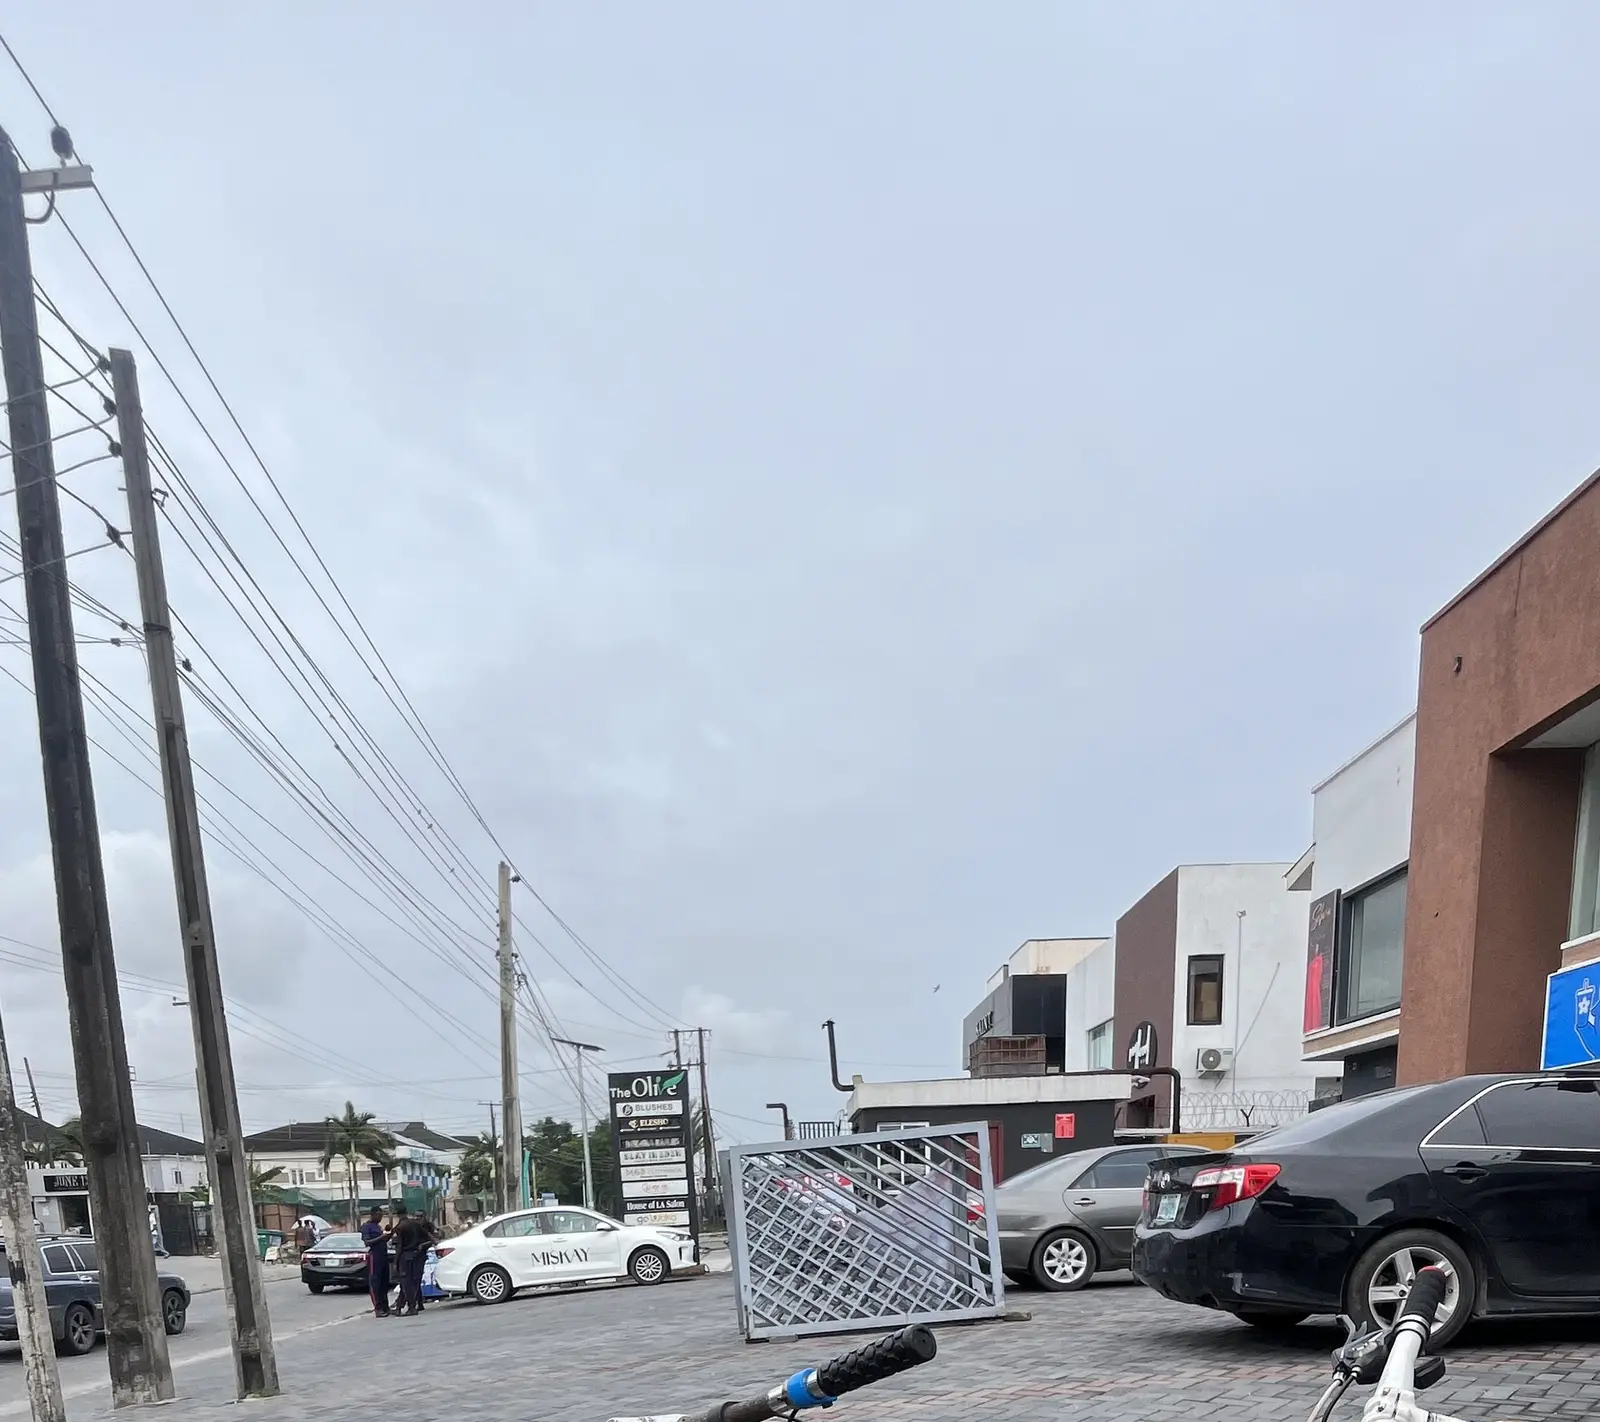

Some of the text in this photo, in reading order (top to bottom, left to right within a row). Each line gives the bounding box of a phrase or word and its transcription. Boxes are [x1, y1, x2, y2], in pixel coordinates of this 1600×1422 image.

[609, 1075, 680, 1098] The Olive
[53, 1175, 79, 1187] JUNE
[626, 1202, 647, 1211] House
[648, 1201, 655, 1209] of
[531, 1248, 590, 1267] MISKAY
